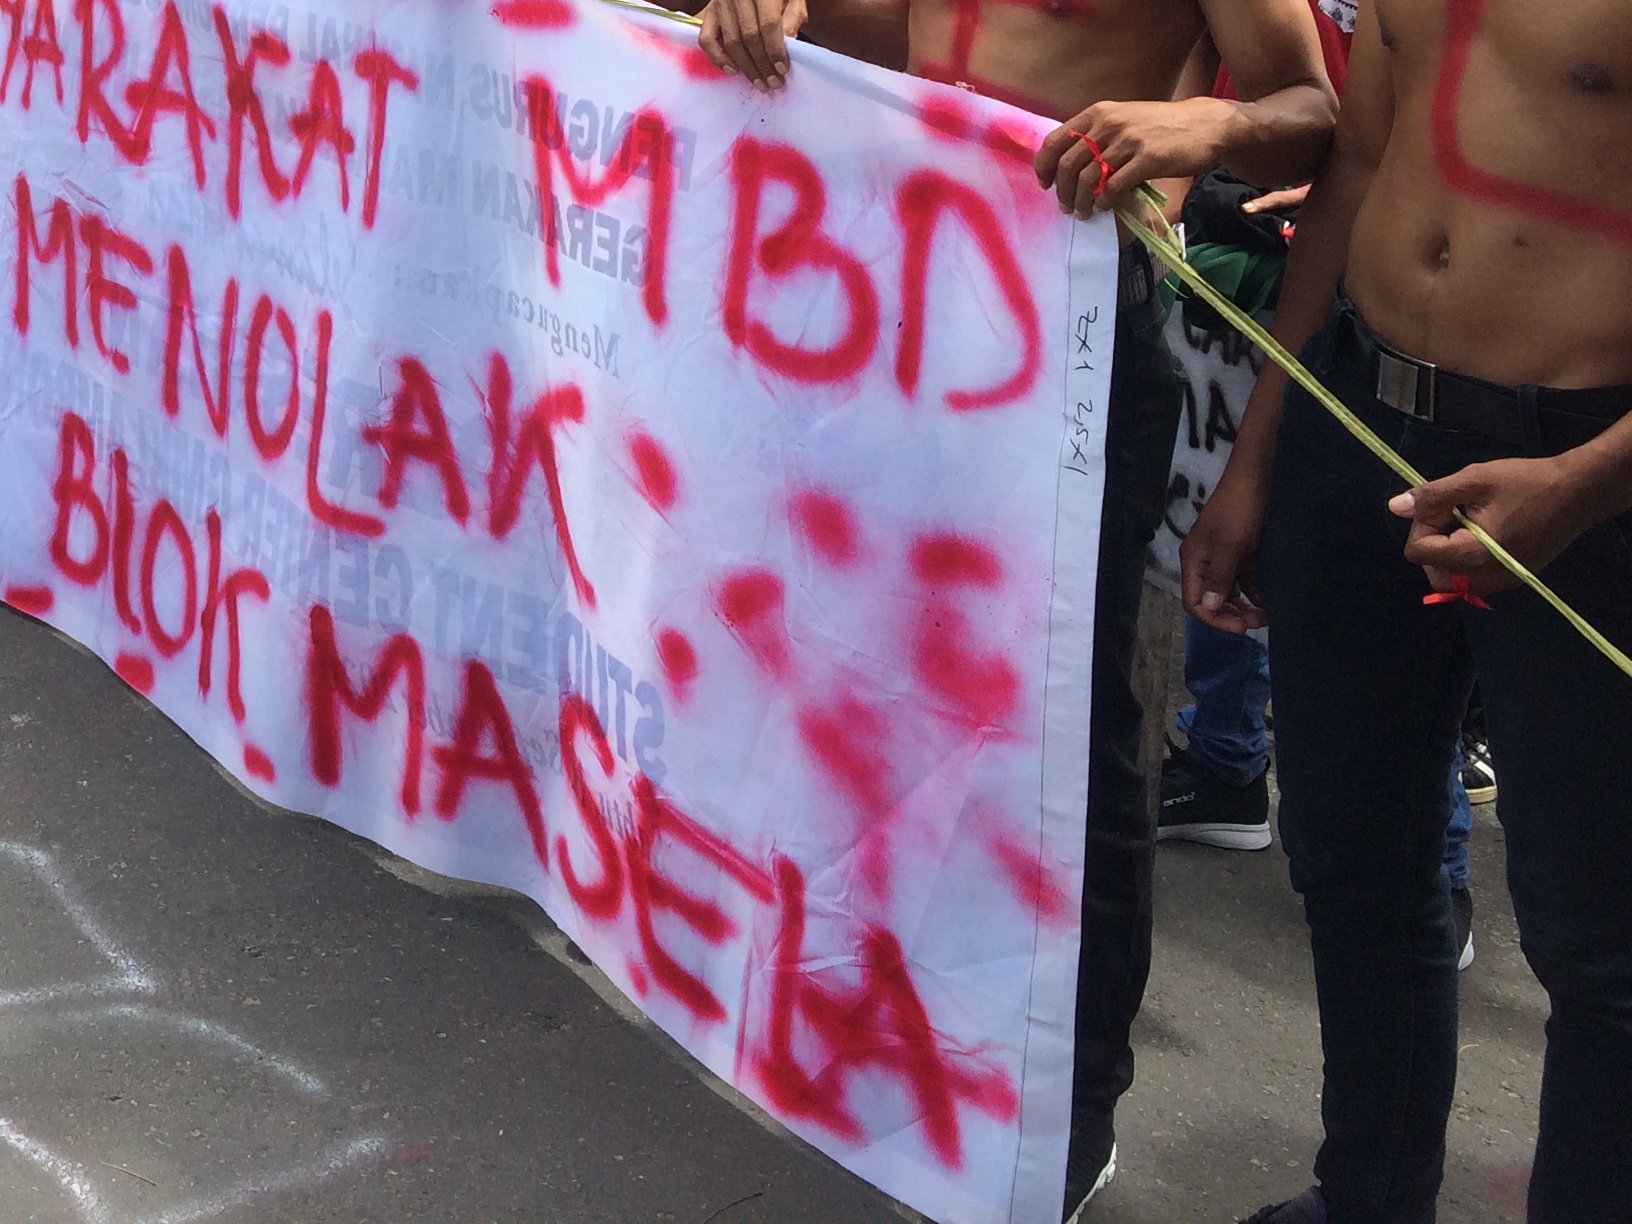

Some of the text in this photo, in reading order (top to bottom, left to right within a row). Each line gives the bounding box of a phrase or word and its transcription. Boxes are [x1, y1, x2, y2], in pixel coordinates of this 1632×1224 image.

[11, 172, 596, 606] MENOLAK
[522, 73, 1044, 413] MBD
[50, 410, 272, 724] BLOK
[304, 604, 1020, 1172] MASELA
